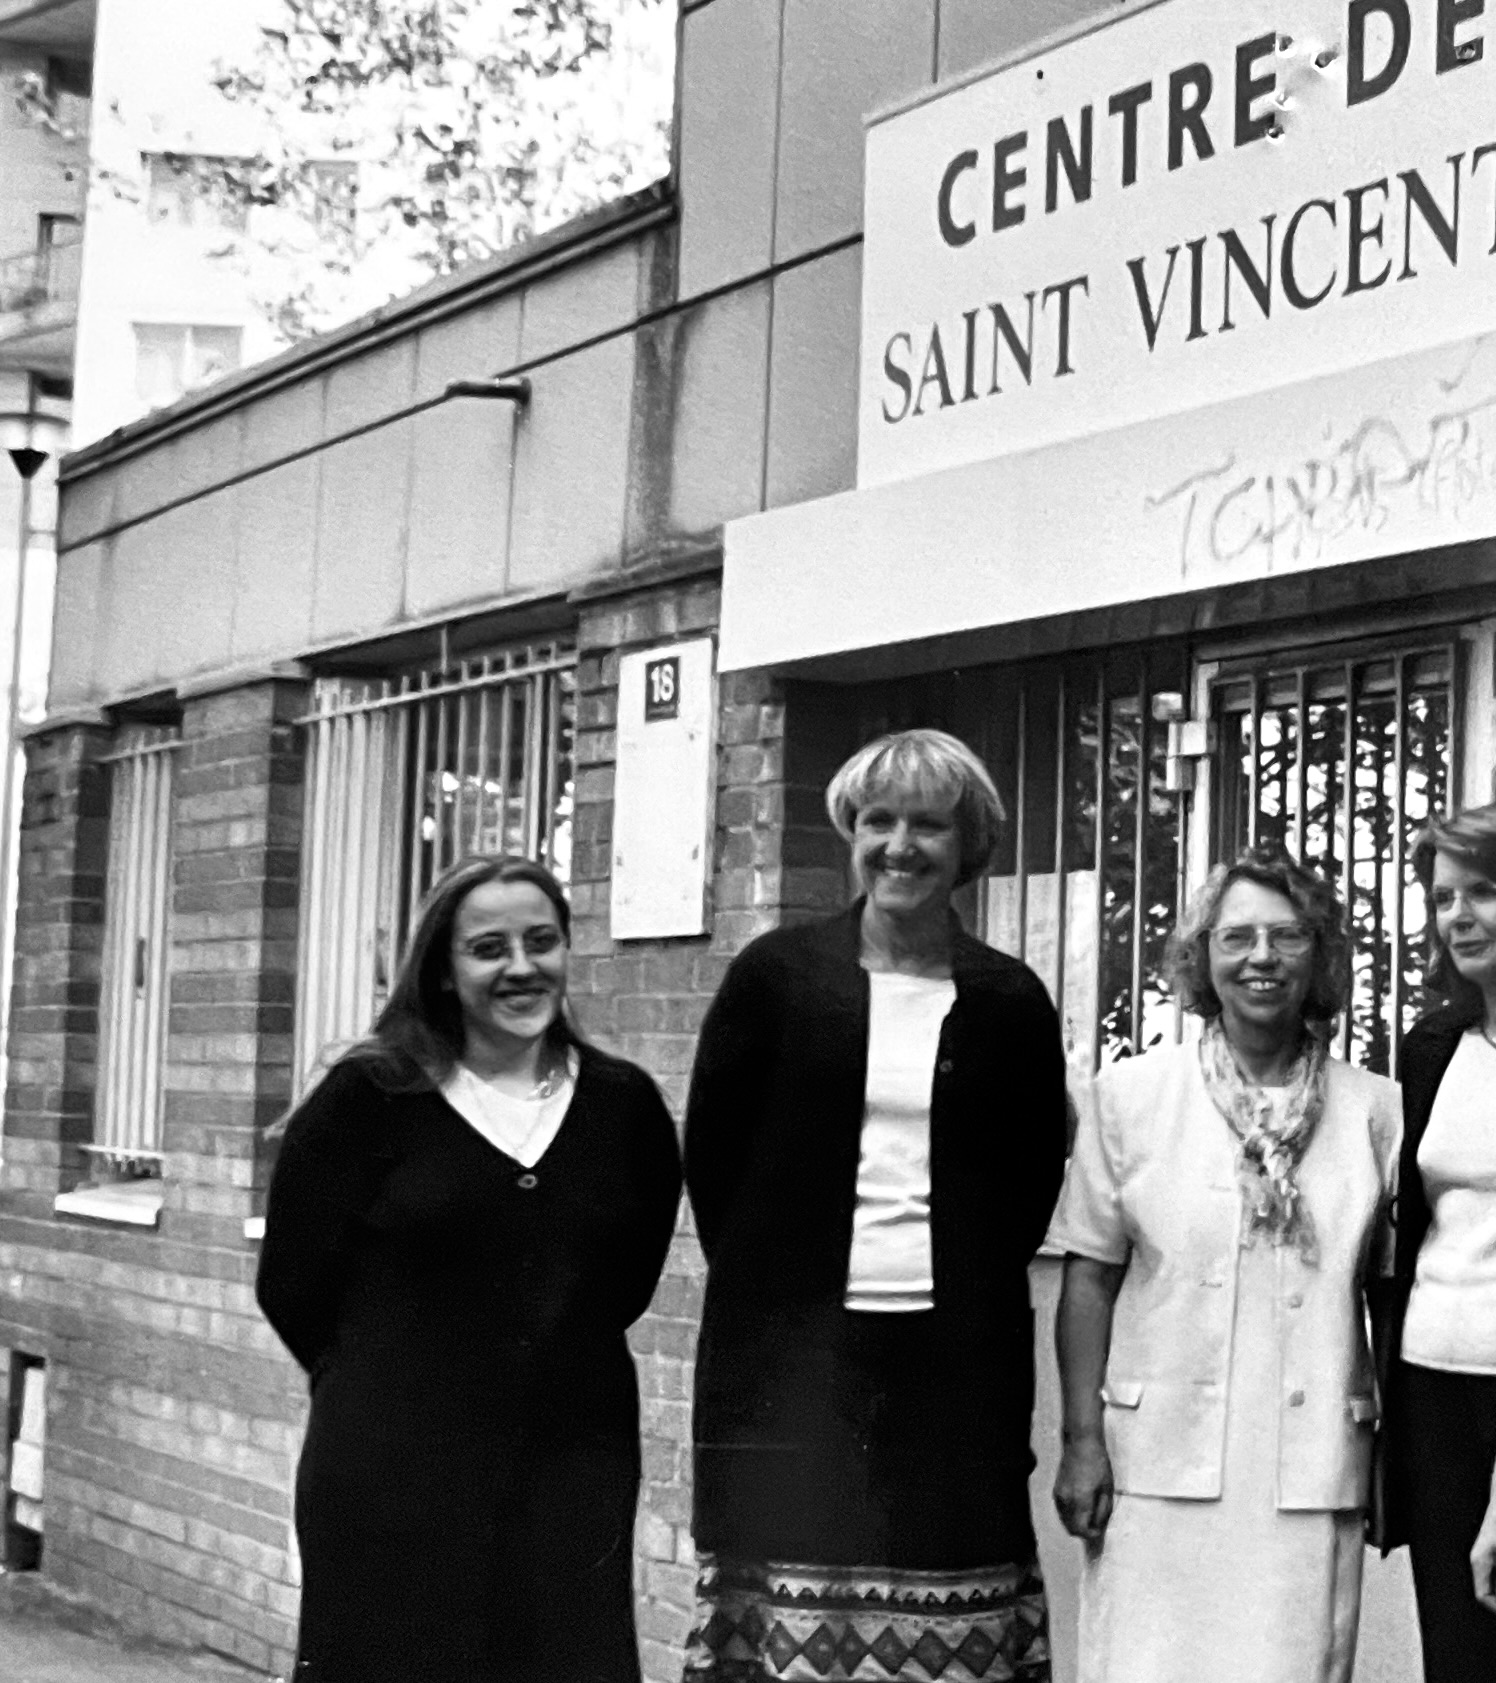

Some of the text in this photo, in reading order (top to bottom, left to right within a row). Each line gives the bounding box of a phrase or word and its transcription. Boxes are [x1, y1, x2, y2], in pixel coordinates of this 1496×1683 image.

[937, 0, 1485, 247] CENTRE DE
[882, 276, 1088, 424] SAINT
[650, 663, 675, 703] 18
